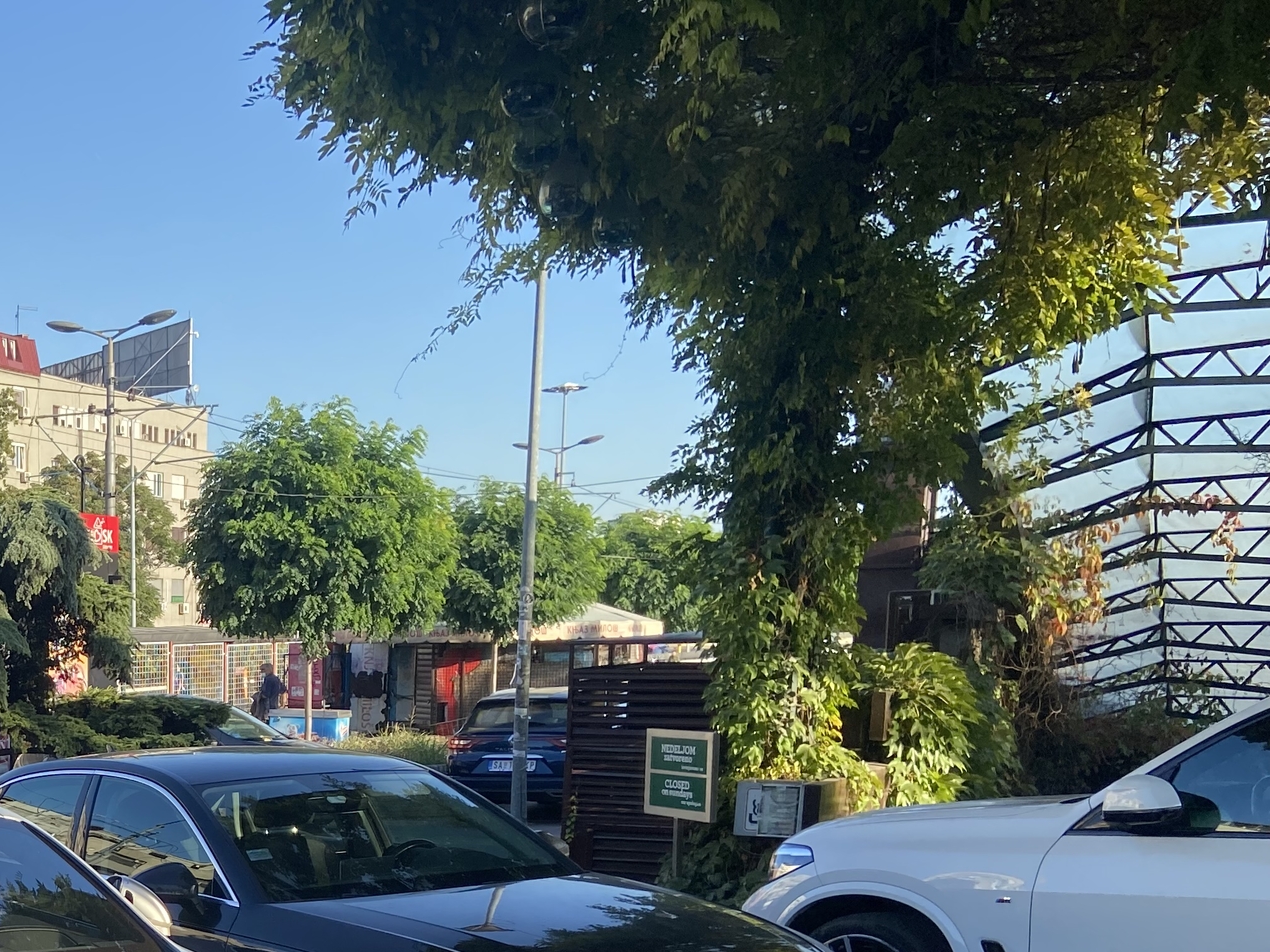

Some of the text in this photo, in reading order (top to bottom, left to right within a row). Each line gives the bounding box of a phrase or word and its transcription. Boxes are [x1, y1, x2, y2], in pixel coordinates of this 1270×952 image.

[661, 744, 696, 756] NEDELJOM
[663, 754, 693, 764] zatvoreno
[664, 779, 690, 790] CLOSED
[661, 788, 693, 800] on sundays
